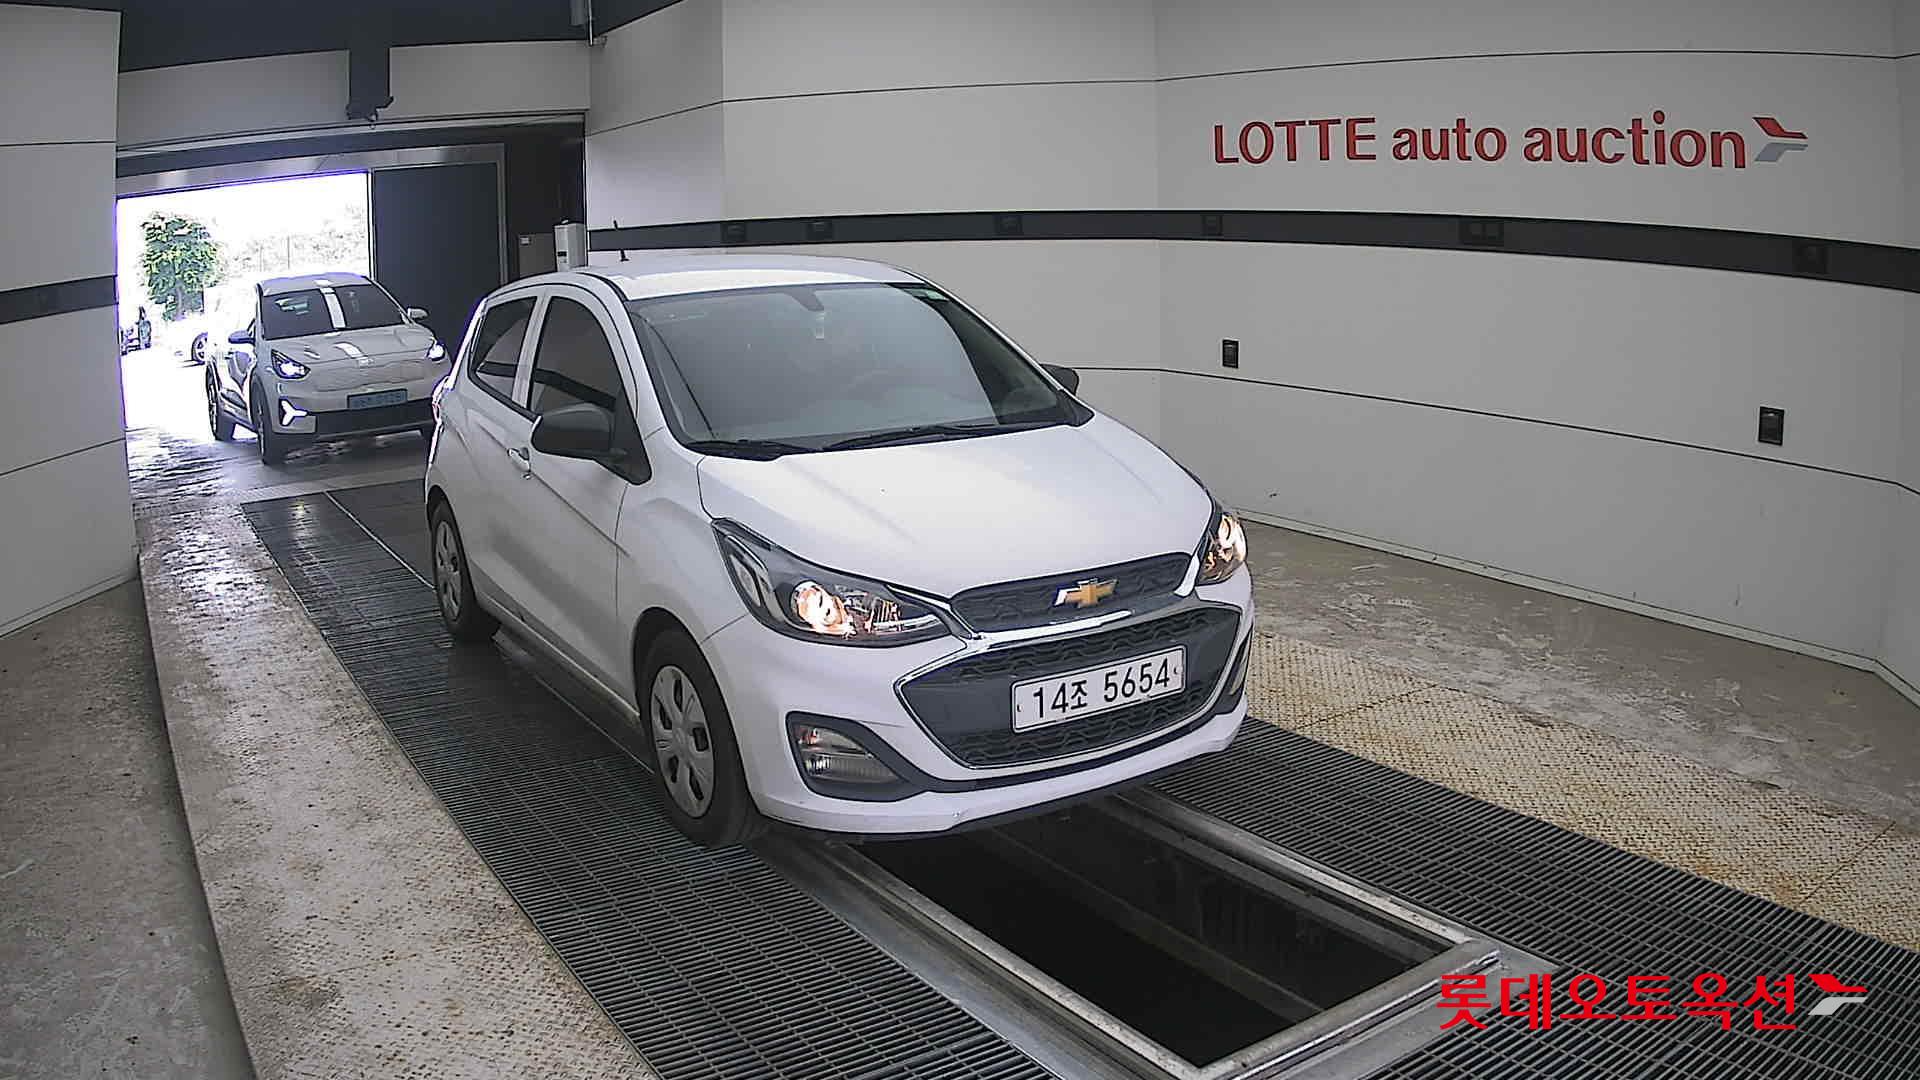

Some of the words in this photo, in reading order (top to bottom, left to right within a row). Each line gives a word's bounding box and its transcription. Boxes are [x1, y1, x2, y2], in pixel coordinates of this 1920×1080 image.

[1213, 117, 1377, 164] LOTTE
[1392, 117, 1507, 162] auto
[1523, 110, 1746, 169] auction
[1033, 680, 1088, 718] 14조
[1103, 658, 1170, 703] 5654
